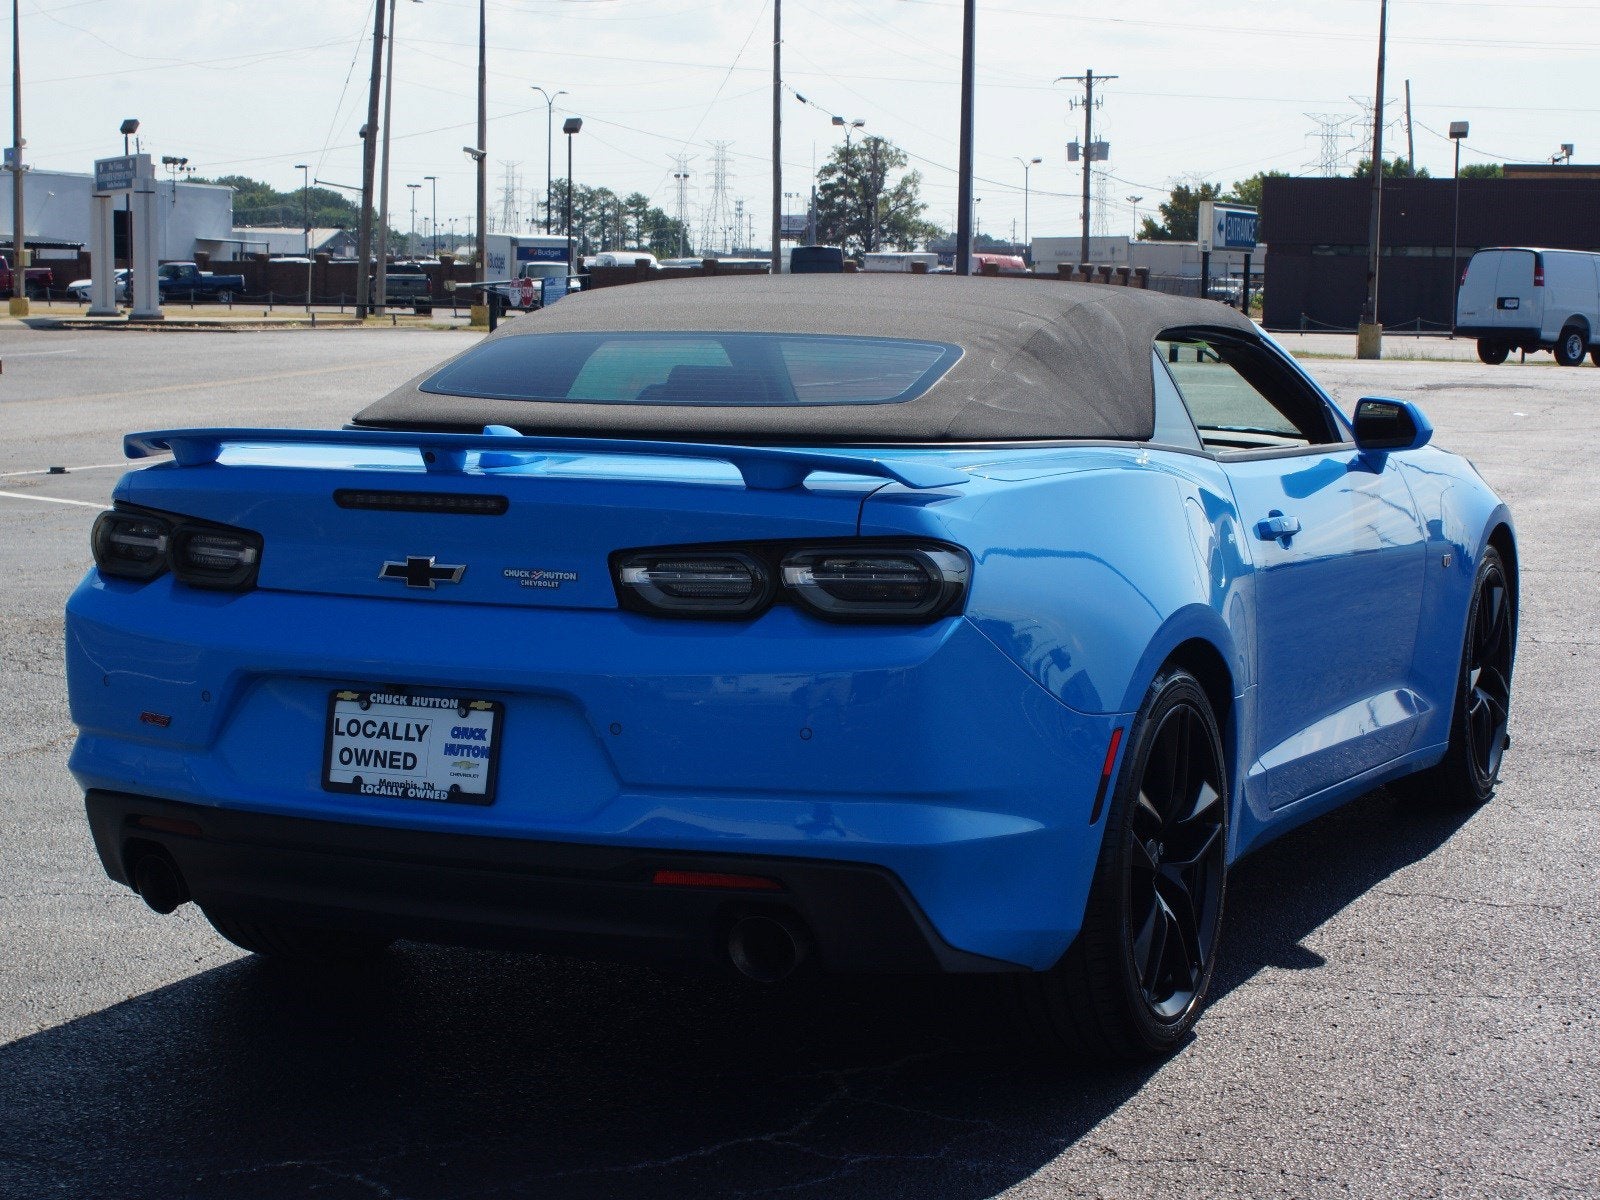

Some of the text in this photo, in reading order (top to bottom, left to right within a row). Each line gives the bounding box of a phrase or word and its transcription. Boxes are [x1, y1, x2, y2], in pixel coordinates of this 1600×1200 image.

[1226, 216, 1256, 242] ENTRANCE
[537, 249, 561, 257] Budget
[504, 569, 577, 580] CHUCK HUTTON
[520, 579, 559, 588] CHEVROLET
[369, 692, 459, 709] CHUCK HUTTON
[334, 717, 430, 742] LOCALLY
[450, 725, 488, 741] CHUCK
[339, 746, 418, 771] OWNED
[444, 742, 491, 759] HUTTON
[449, 771, 480, 779] CHEVROLET
[360, 784, 449, 800] LOCALLY OWNED
[422, 781, 435, 791] TN
